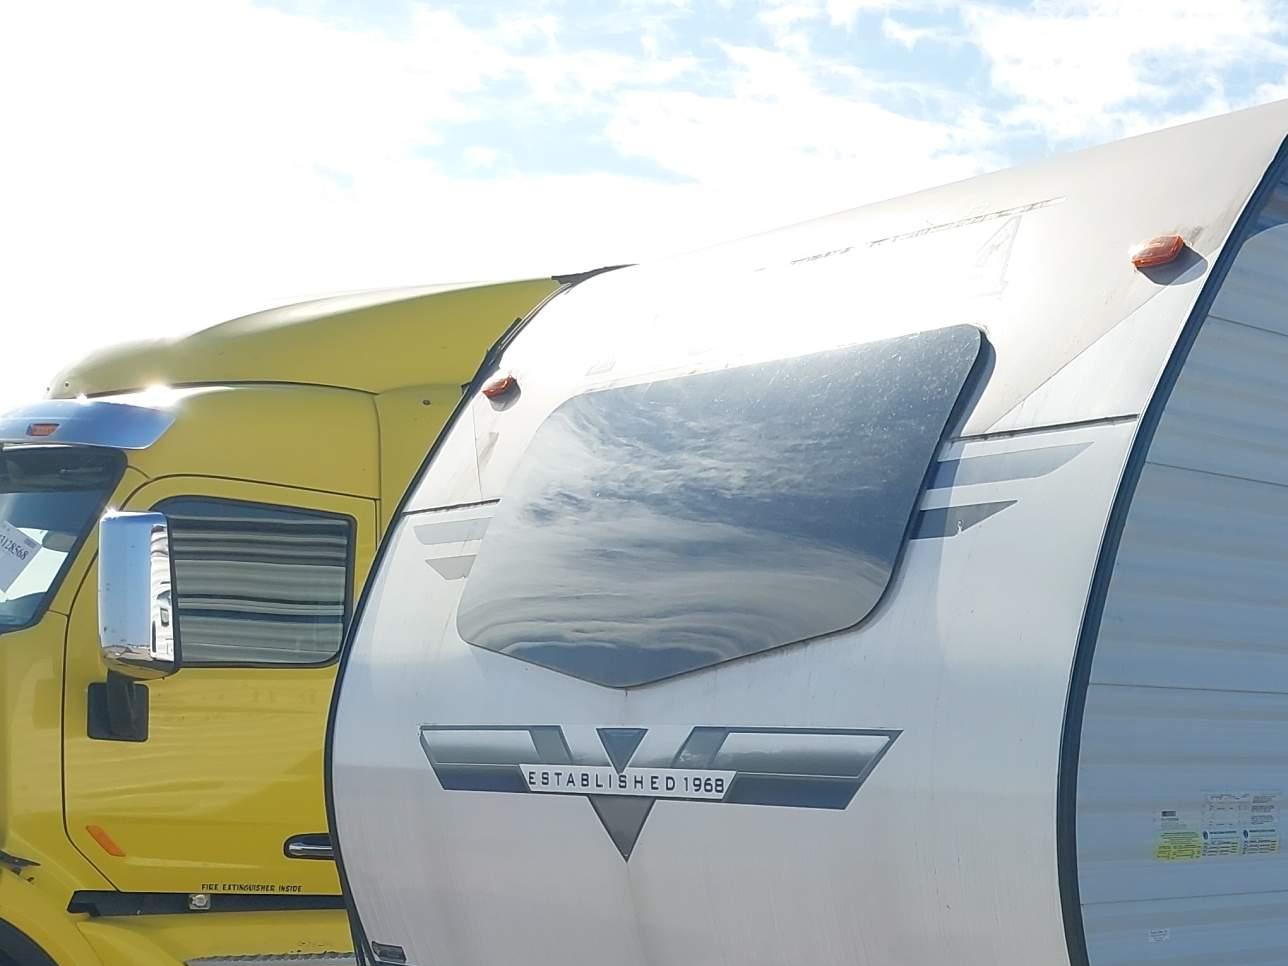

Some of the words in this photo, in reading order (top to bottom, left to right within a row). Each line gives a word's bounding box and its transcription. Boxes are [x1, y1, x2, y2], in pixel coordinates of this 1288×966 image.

[528, 771, 676, 792] ESTABLISHED
[683, 776, 725, 794] 1968
[201, 883, 219, 891] FIRE
[222, 884, 275, 892] EXTINGUISHER
[278, 885, 303, 893] INSIDE
